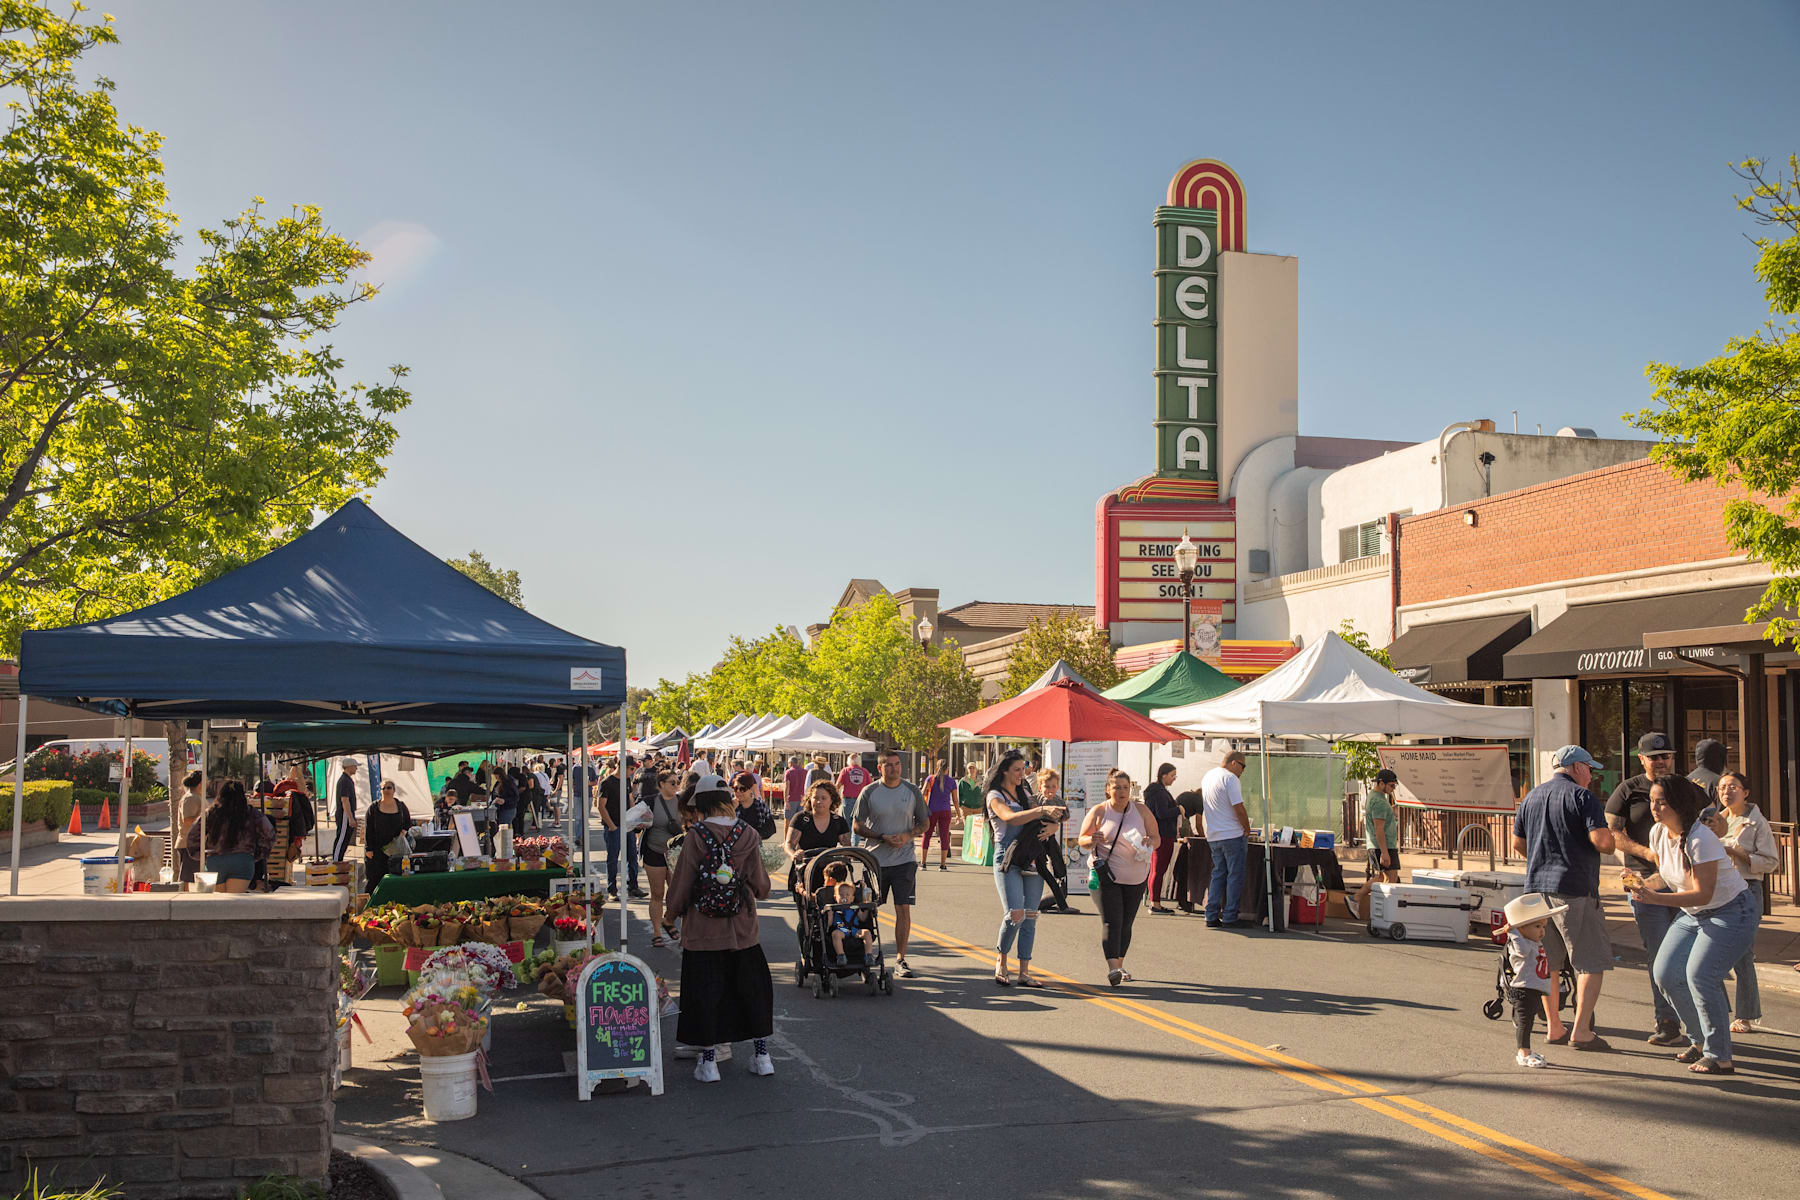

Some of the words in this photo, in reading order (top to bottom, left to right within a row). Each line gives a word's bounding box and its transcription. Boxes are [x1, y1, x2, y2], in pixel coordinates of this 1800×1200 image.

[1175, 225, 1211, 471] DELTA
[1139, 544, 1221, 557] REMOING
[1152, 564, 1175, 577] SEE
[1192, 564, 1212, 577] OU
[1577, 648, 1644, 671] corcoran
[1657, 650, 1685, 660] GLOL
[1688, 647, 1714, 659] LIVING
[1400, 752, 1419, 761] HOME
[1419, 752, 1437, 761] MAID
[592, 981, 643, 1004] FRESH
[589, 1005, 649, 1026] FLOWERS
[595, 1025, 612, 1048] $4
[629, 1036, 644, 1048] $7
[613, 1048, 620, 1058] 3
